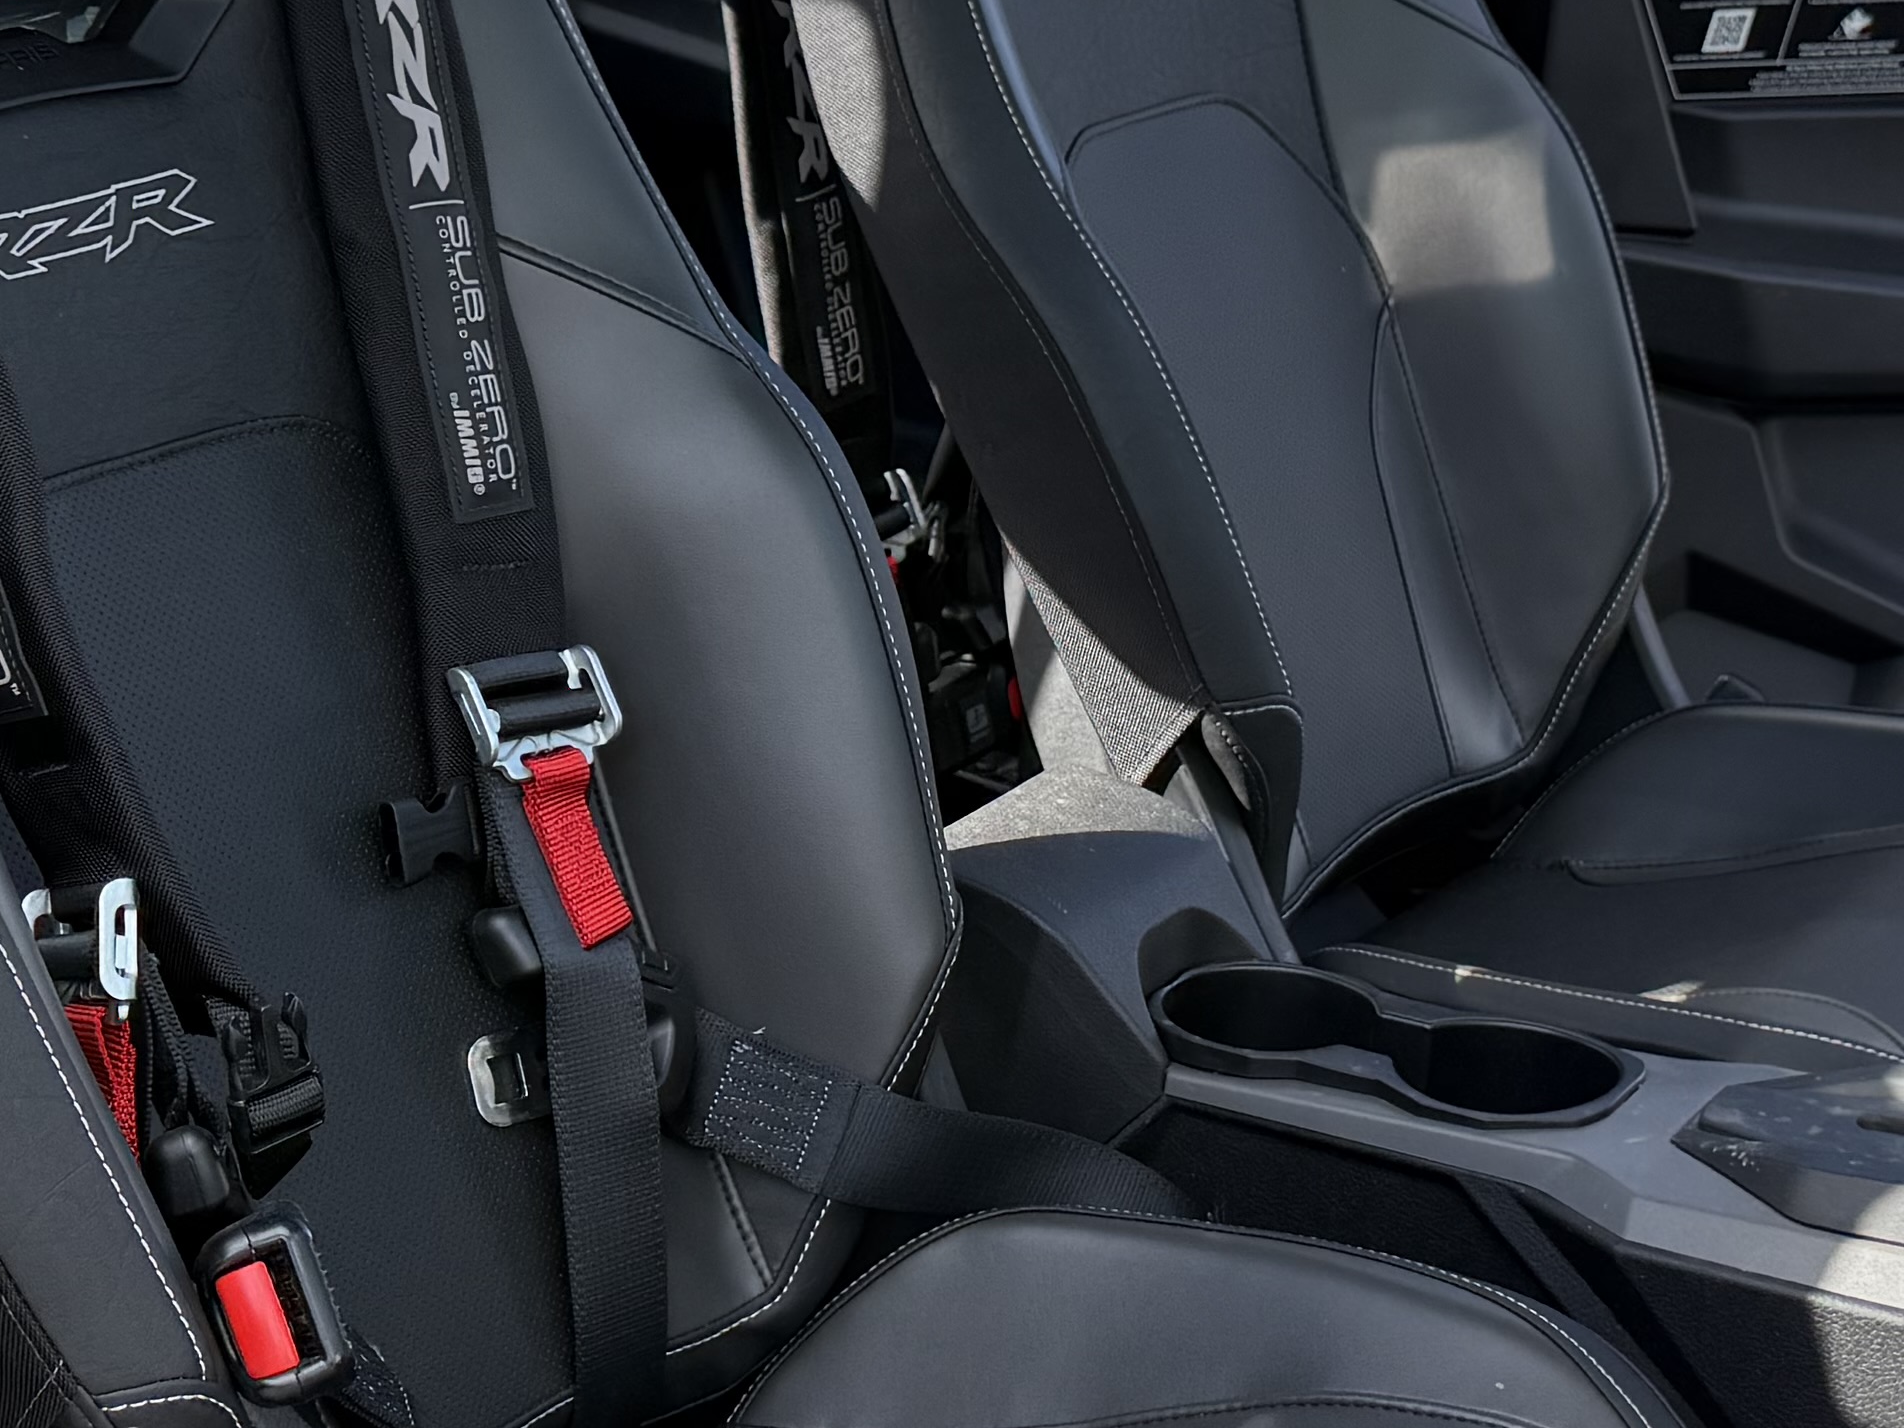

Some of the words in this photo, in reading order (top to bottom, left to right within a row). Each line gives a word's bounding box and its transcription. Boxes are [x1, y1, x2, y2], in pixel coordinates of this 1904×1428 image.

[446, 214, 487, 324] SUB
[820, 194, 850, 278] SUB
[435, 214, 470, 340] CONTROLLED
[462, 349, 499, 484] DECELERATOR
